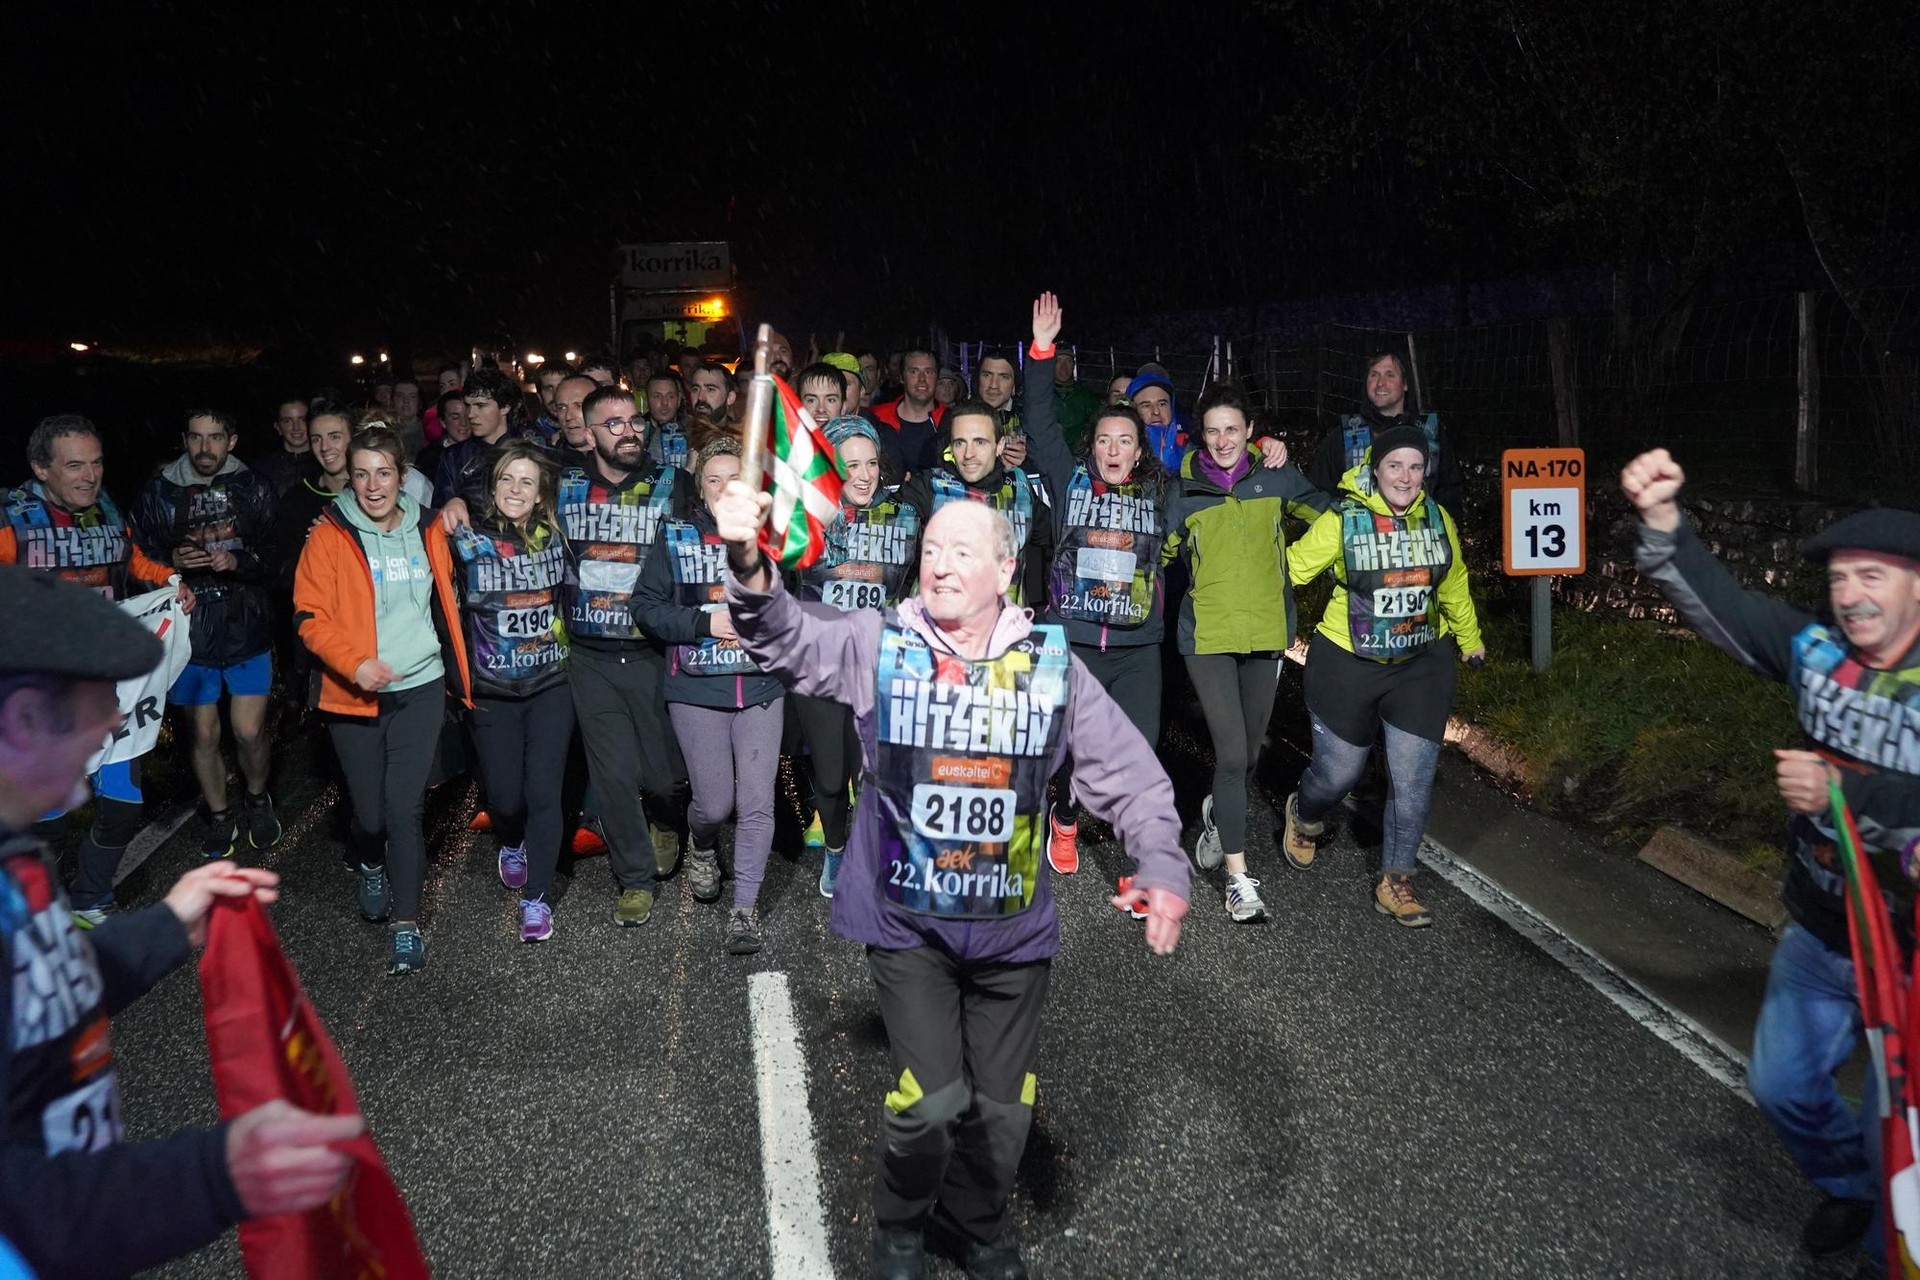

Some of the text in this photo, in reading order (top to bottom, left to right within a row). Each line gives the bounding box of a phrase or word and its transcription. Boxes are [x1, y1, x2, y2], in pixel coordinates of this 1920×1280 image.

[630, 249, 722, 274] korrika
[1507, 459, 1582, 478] NA-170
[1529, 498, 1561, 517] km
[1525, 524, 1567, 558] 13
[832, 584, 881, 609] 2189
[1060, 591, 1142, 618] 22.korrika
[507, 609, 549, 635] 2190
[1360, 624, 1436, 649] 22.korrika
[487, 642, 568, 670] 22.korrika
[938, 763, 991, 779] euskaltel
[925, 793, 1005, 836] 2188
[935, 843, 976, 870] aek
[889, 858, 1023, 899] 22.korrika
